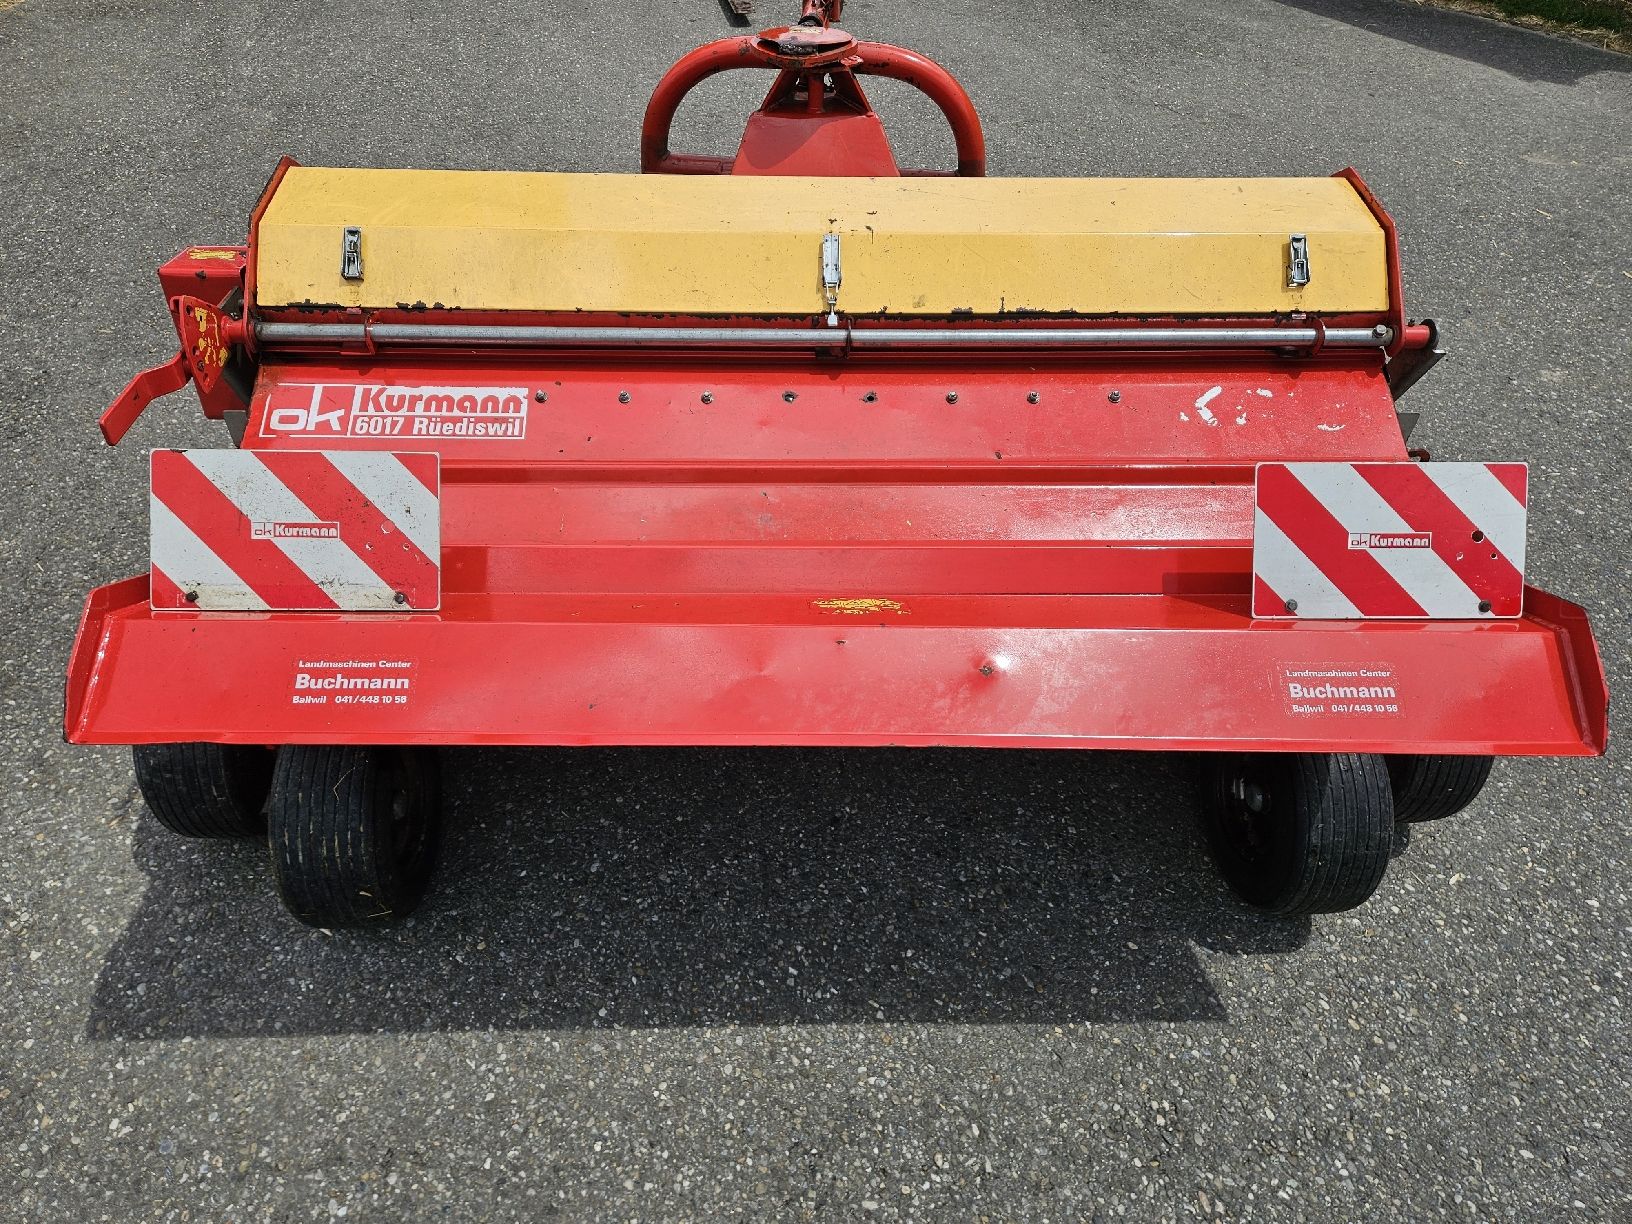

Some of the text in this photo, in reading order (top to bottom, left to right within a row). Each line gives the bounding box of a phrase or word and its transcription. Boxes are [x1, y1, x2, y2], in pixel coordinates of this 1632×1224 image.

[269, 385, 524, 431] ok Kurmann
[354, 416, 520, 436] 6017 Rüediswil
[275, 524, 337, 537] Kurmann
[1370, 534, 1429, 547] Kurmann
[298, 660, 412, 668] Landmaschinen Center
[1286, 669, 1391, 677] Landmaschinen Center
[295, 673, 409, 689] Buchmann
[1288, 682, 1396, 698] Buchmann
[292, 695, 327, 704] Ballwil
[381, 695, 392, 704] 10
[1292, 704, 1324, 713] Ballwil
[1374, 704, 1385, 713] 10
